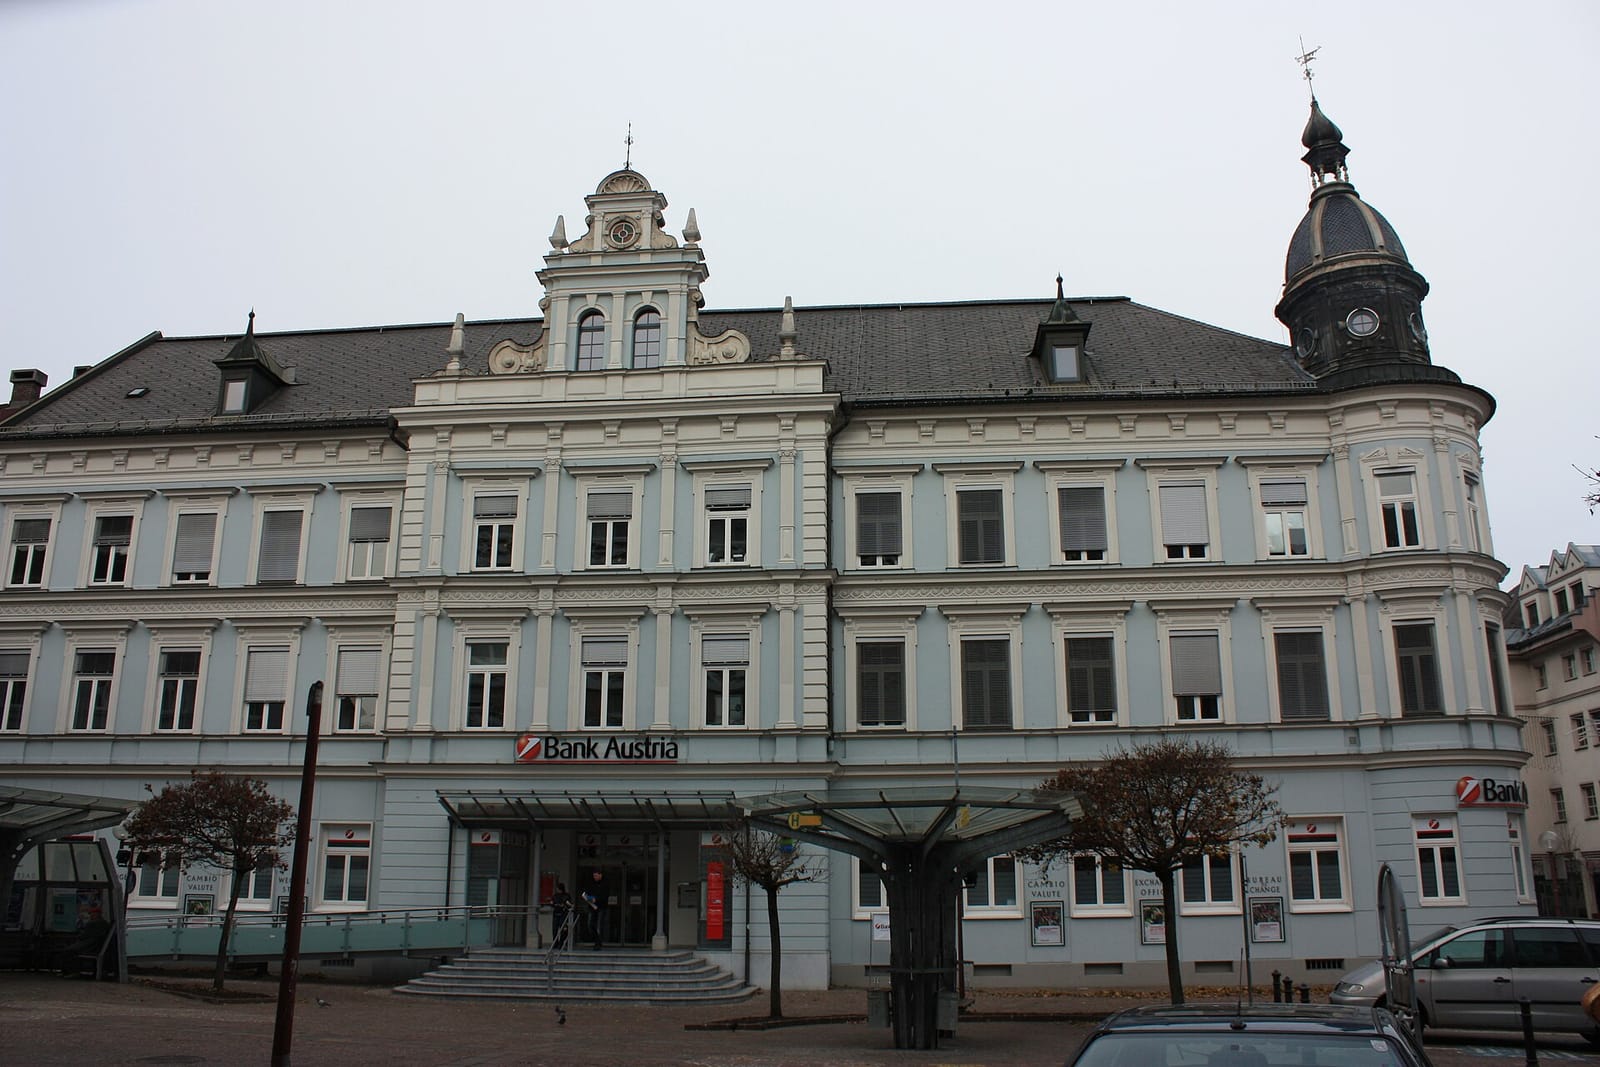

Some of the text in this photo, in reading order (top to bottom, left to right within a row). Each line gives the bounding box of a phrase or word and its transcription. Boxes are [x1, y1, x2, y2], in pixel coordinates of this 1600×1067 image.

[544, 735, 678, 759] Bank Austria
[1483, 778, 1521, 803] Bank
[1031, 890, 1061, 898] VALUTE
